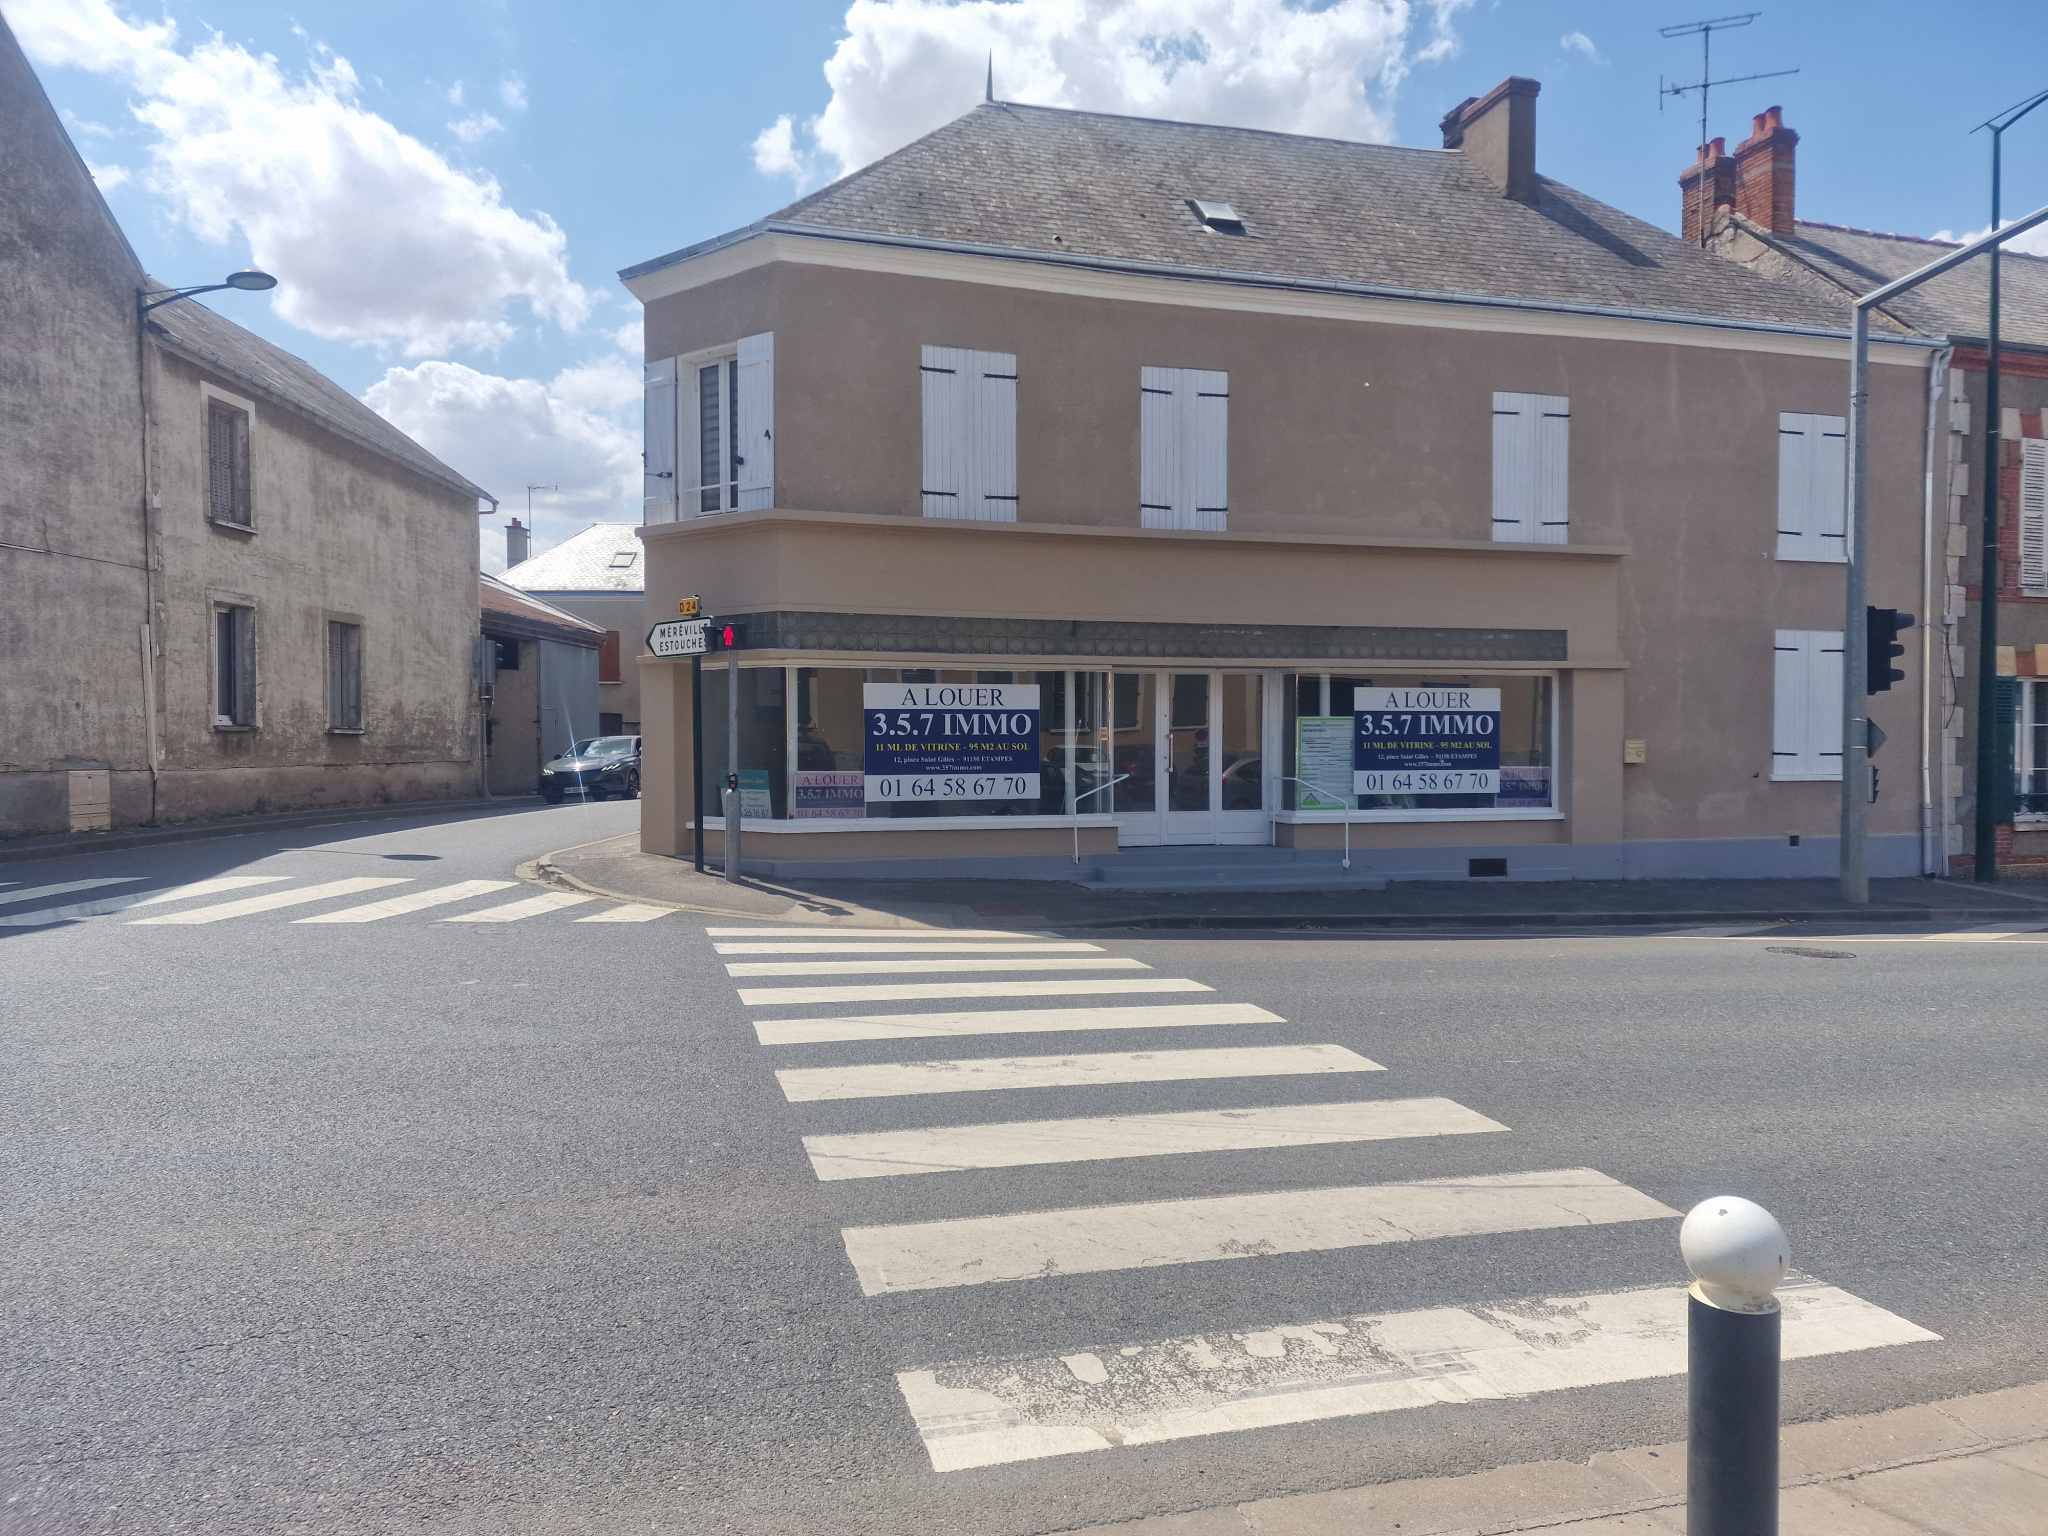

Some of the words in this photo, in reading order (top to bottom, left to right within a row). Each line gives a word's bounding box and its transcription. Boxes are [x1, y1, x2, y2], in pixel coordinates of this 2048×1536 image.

[679, 602, 684, 613] D
[687, 601, 696, 612] 24
[660, 623, 707, 638] MÉRÉVILL
[660, 638, 706, 651] ESTOUCHE
[901, 688, 918, 706] A
[924, 688, 1005, 707] LOUER
[1385, 692, 1399, 708] A
[1404, 691, 1472, 708] LOUER
[872, 713, 934, 736] 3.5.7
[942, 713, 1032, 736] IMMO
[1361, 714, 1413, 735] 3.5.7
[1418, 714, 1494, 735] IMMO
[876, 743, 884, 751] 11
[887, 743, 903, 751] ML
[905, 743, 918, 751] DE
[921, 743, 961, 751] VITRINE
[968, 743, 979, 751] 95
[981, 743, 994, 751] M2
[996, 743, 1009, 751] AU
[1011, 743, 1030, 751] SOL
[801, 776, 811, 785] A
[815, 774, 858, 785] LOUER
[880, 778, 901, 797] 01
[912, 778, 935, 796] 64
[942, 778, 966, 796] 58
[973, 777, 996, 796] 67
[1003, 776, 1026, 795] 70
[1366, 774, 1385, 791] 01
[1392, 773, 1413, 790] 64
[1418, 773, 1438, 790] 58
[1443, 773, 1463, 790] 67
[1469, 773, 1488, 790] 70
[797, 789, 821, 799] 3.5.7
[825, 789, 863, 799] IMMO
[798, 809, 807, 817] 01
[811, 809, 823, 817] 64
[826, 809, 836, 817] 58
[838, 809, 849, 817] 67
[854, 809, 863, 817] 70
